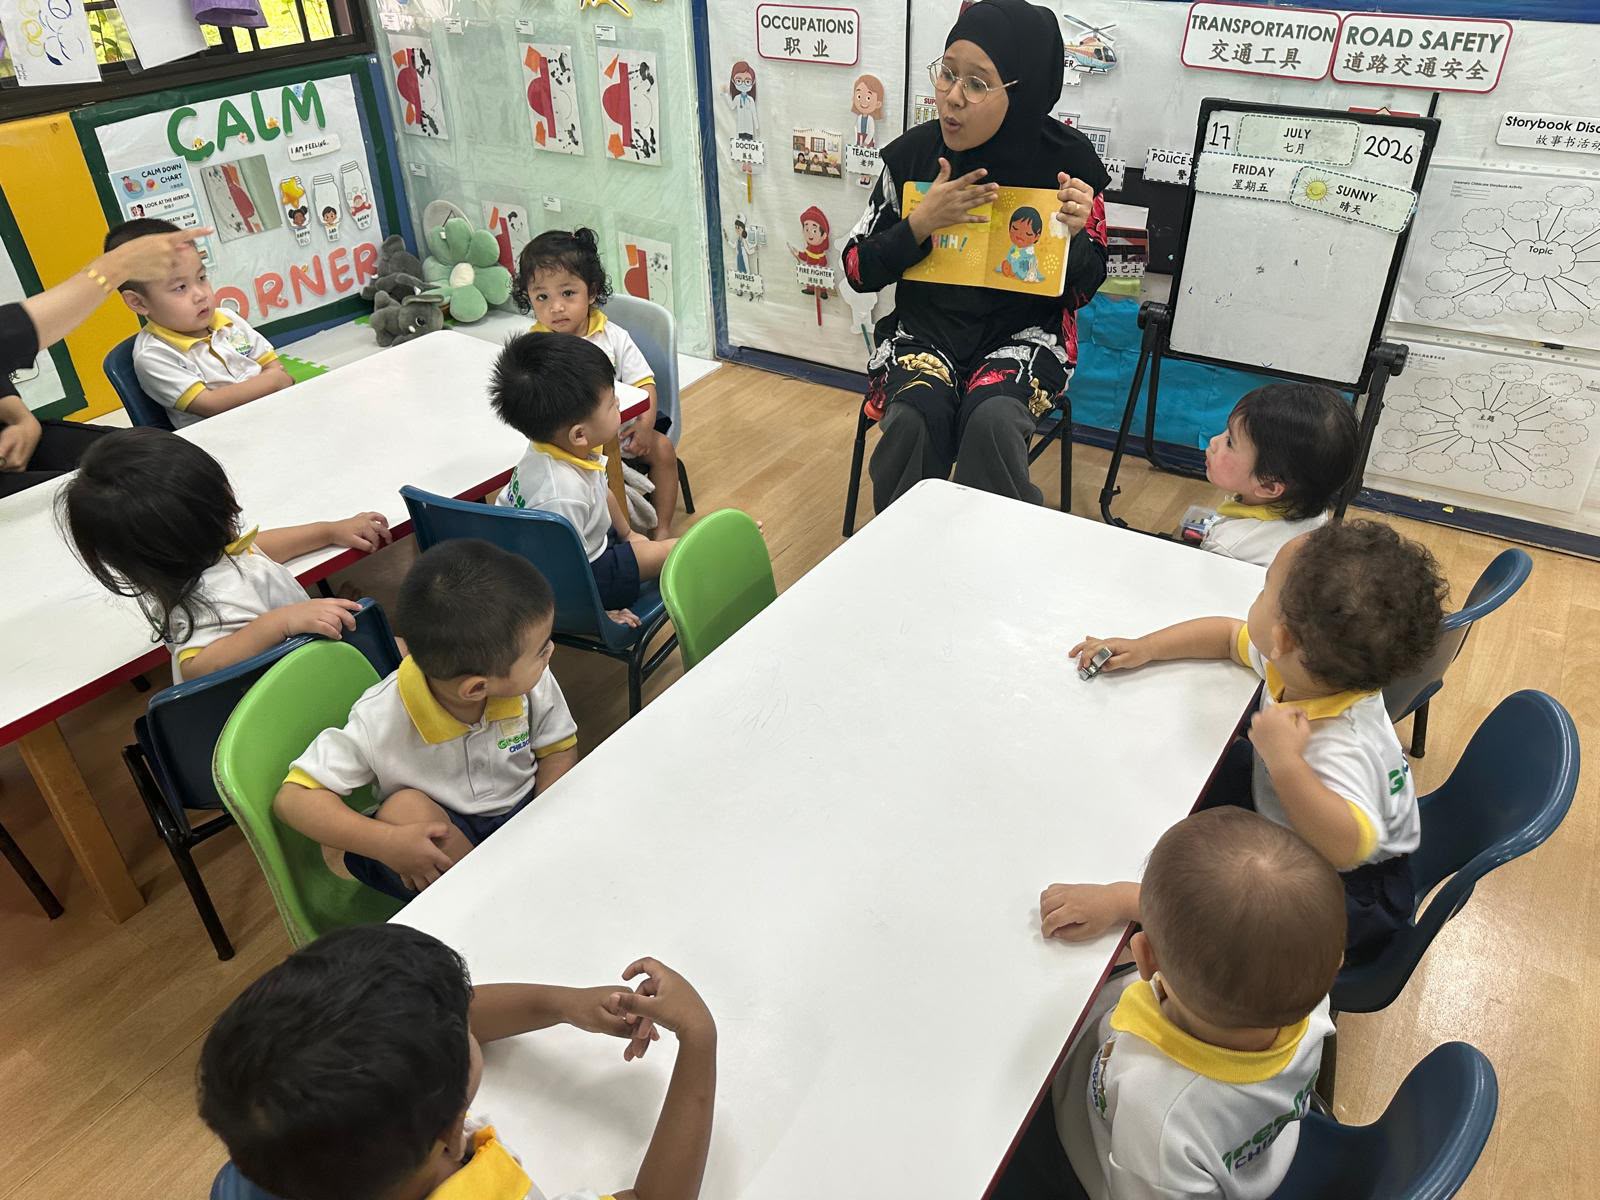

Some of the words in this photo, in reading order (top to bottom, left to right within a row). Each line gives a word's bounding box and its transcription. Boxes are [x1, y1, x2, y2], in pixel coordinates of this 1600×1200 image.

[761, 15, 854, 35] OCCUPATIONS
[1191, 14, 1336, 43] TRANSPORTATION
[1345, 26, 1414, 48] ROAD
[1419, 30, 1505, 53] SAFETY
[784, 37, 830, 58] 职业
[1208, 39, 1302, 70] 交通工具
[1343, 52, 1489, 81] 道路交通安全
[167, 80, 326, 162] CALM
[1505, 116, 1573, 131] Storybook
[1209, 122, 1231, 150] 17
[1283, 127, 1312, 140] JULY
[735, 142, 759, 151] DOCTOR
[1283, 143, 1306, 155] 七月
[1364, 135, 1414, 165] 2026
[859, 160, 874, 168] 老师
[1152, 153, 1187, 165] POLICE
[141, 167, 161, 178] CALM
[162, 163, 182, 173] DOWN
[1232, 164, 1276, 178] FRIDAY
[160, 173, 183, 184] CHART
[1231, 180, 1269, 193] 星期五
[1336, 184, 1378, 203] SUNNY
[144, 201, 158, 209] LOOK
[1339, 201, 1362, 215] 晴天
[1528, 245, 1554, 256] Topic
[798, 267, 810, 275] FIRE
[810, 269, 832, 278] FIGHTER
[1121, 264, 1140, 274] 巴士
[734, 273, 755, 282] NURSES
